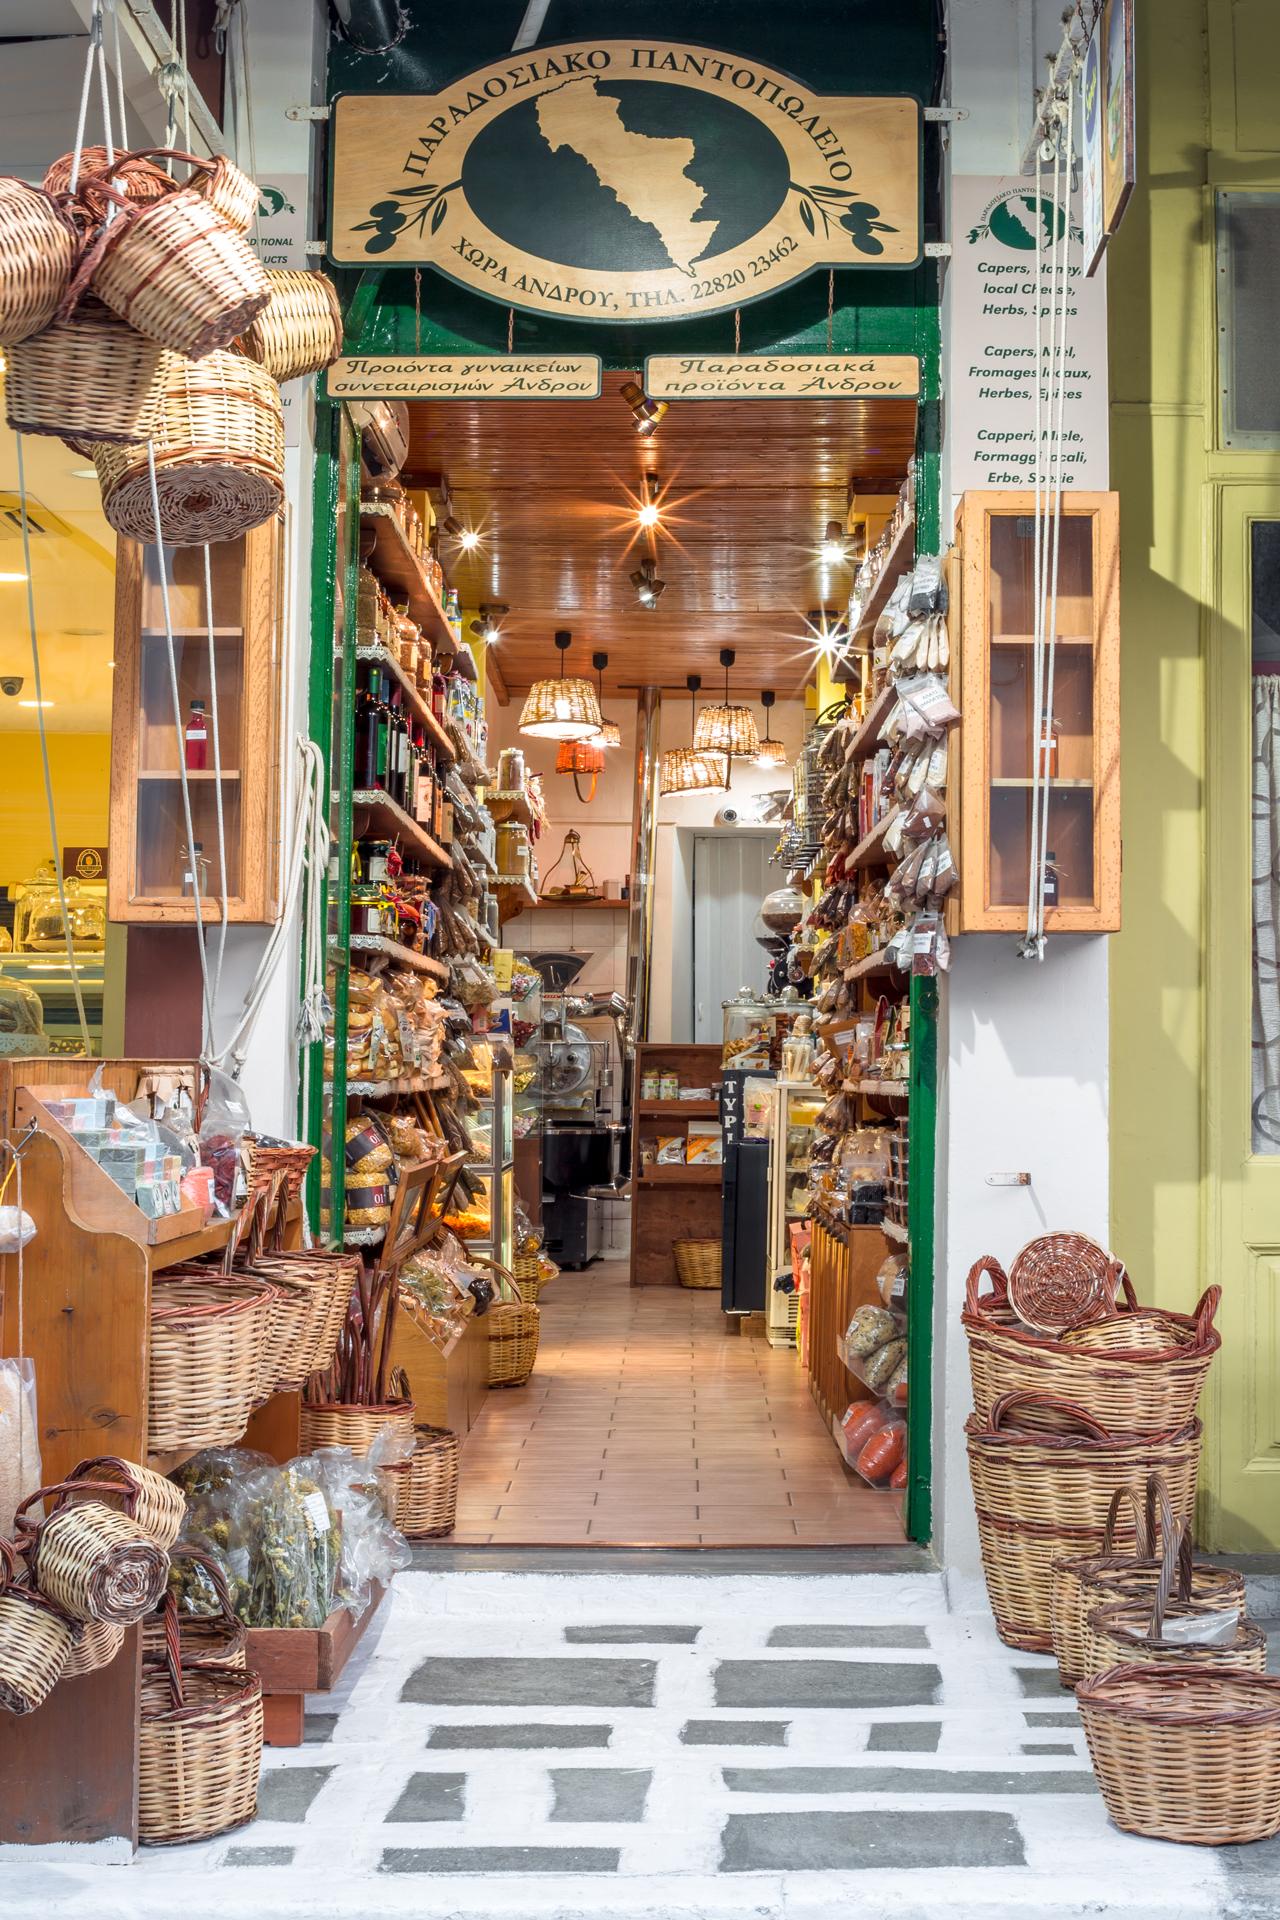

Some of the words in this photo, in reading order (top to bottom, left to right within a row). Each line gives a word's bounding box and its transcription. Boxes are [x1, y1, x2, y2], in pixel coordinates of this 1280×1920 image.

[403, 49, 611, 178] ΠΑΡΑΔΟΣΙΑΚΟ
[630, 48, 853, 182] ΠΑΝΤΟΠΩΛΕΙΟ
[451, 236, 508, 283] ΧΩΡΑ
[512, 274, 619, 312] ΑΝΔΡΟΥ,
[625, 288, 685, 308] ΤΗΛ.
[690, 268, 745, 300] 22820
[748, 236, 799, 278] 23462
[977, 262, 1031, 276] Capers,
[983, 283, 1018, 294] local
[982, 304, 1028, 316] Herbs,
[1031, 304, 1078, 317] Spces
[984, 345, 1037, 359] Capers,
[346, 360, 453, 375] Προιόντα
[461, 361, 582, 376] γυναικείων
[680, 359, 876, 375] Παραδοσιακά
[968, 366, 1037, 380] Fromages
[334, 379, 495, 394] συνεταιρισμών
[500, 377, 592, 393] Άνδρου
[665, 379, 785, 394] προϊόντα
[798, 376, 902, 393] Άνδρου
[979, 388, 1033, 400] Herbes,
[977, 429, 1036, 443] Capperi,
[974, 451, 1042, 464] Formaggi
[1045, 451, 1087, 464] ocali,
[988, 472, 1023, 484] Erbe,
